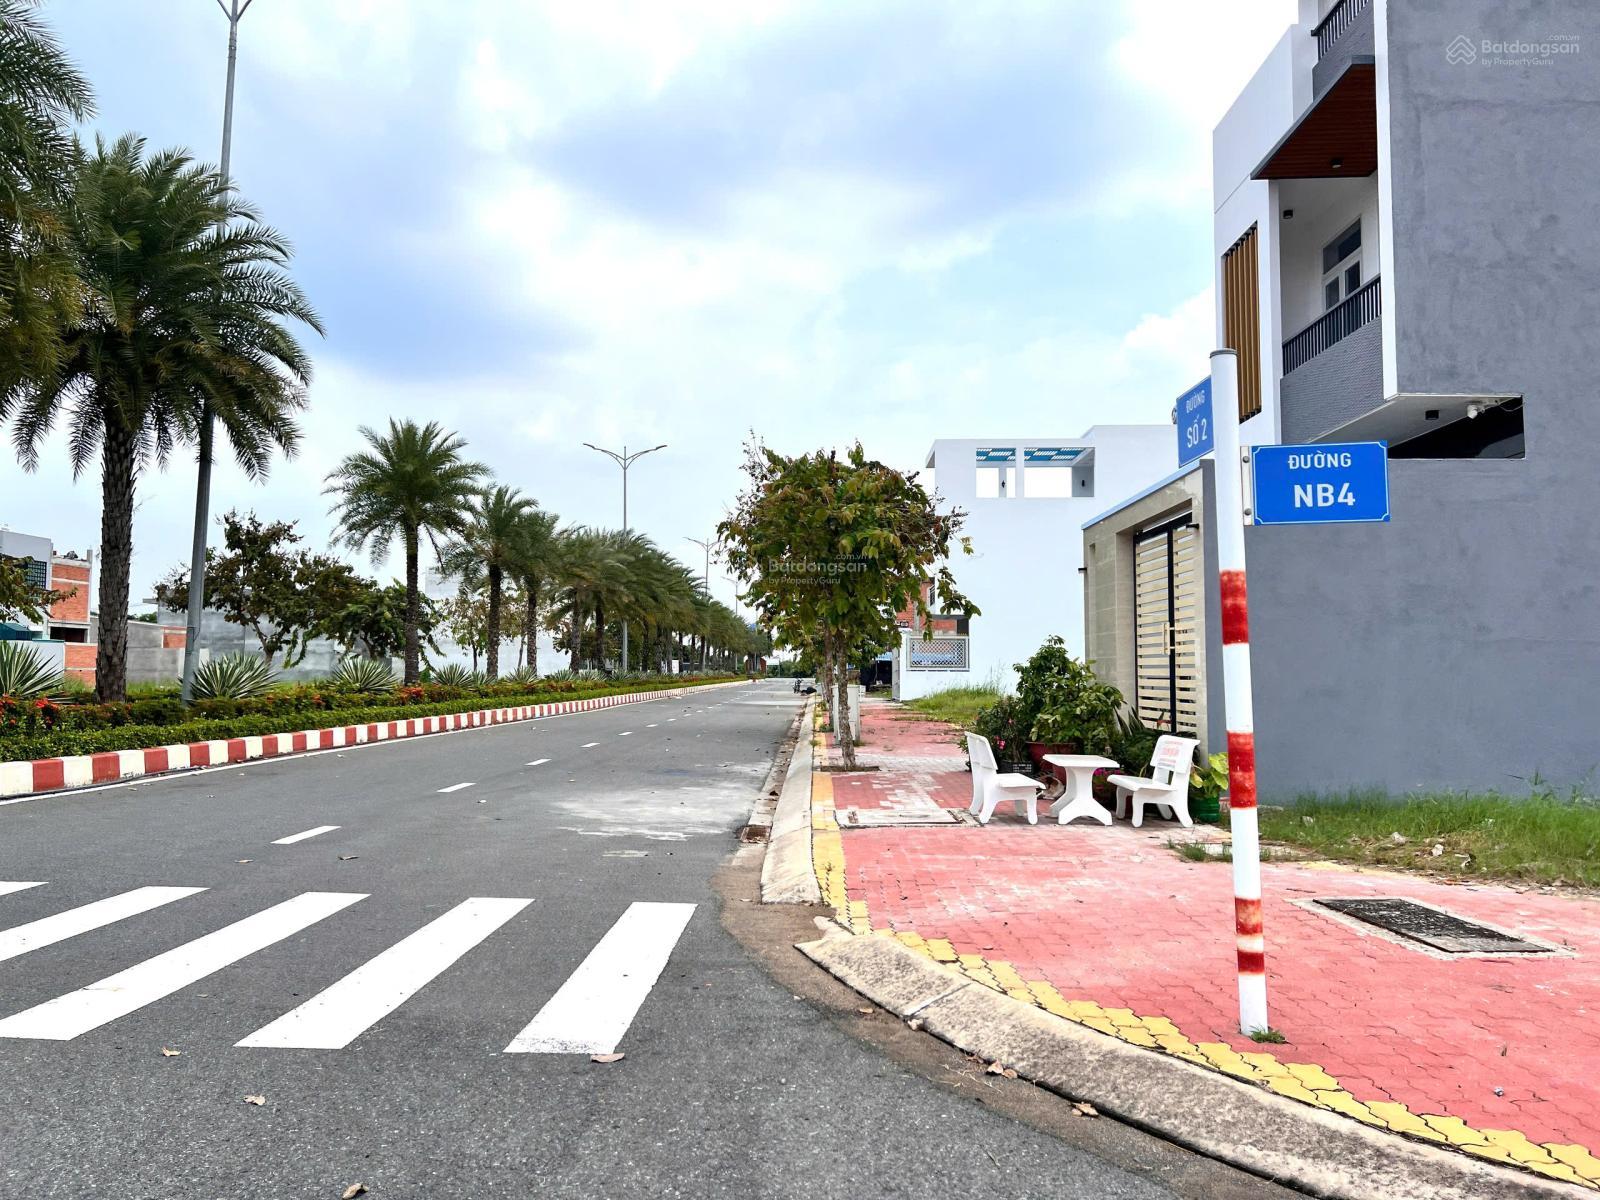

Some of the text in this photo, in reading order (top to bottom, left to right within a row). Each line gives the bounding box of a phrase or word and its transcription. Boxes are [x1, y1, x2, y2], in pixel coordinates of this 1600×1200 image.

[1186, 413, 1208, 448] SỐ 2
[1287, 450, 1352, 470] ĐƯỜNG
[1293, 482, 1356, 508] NB4
